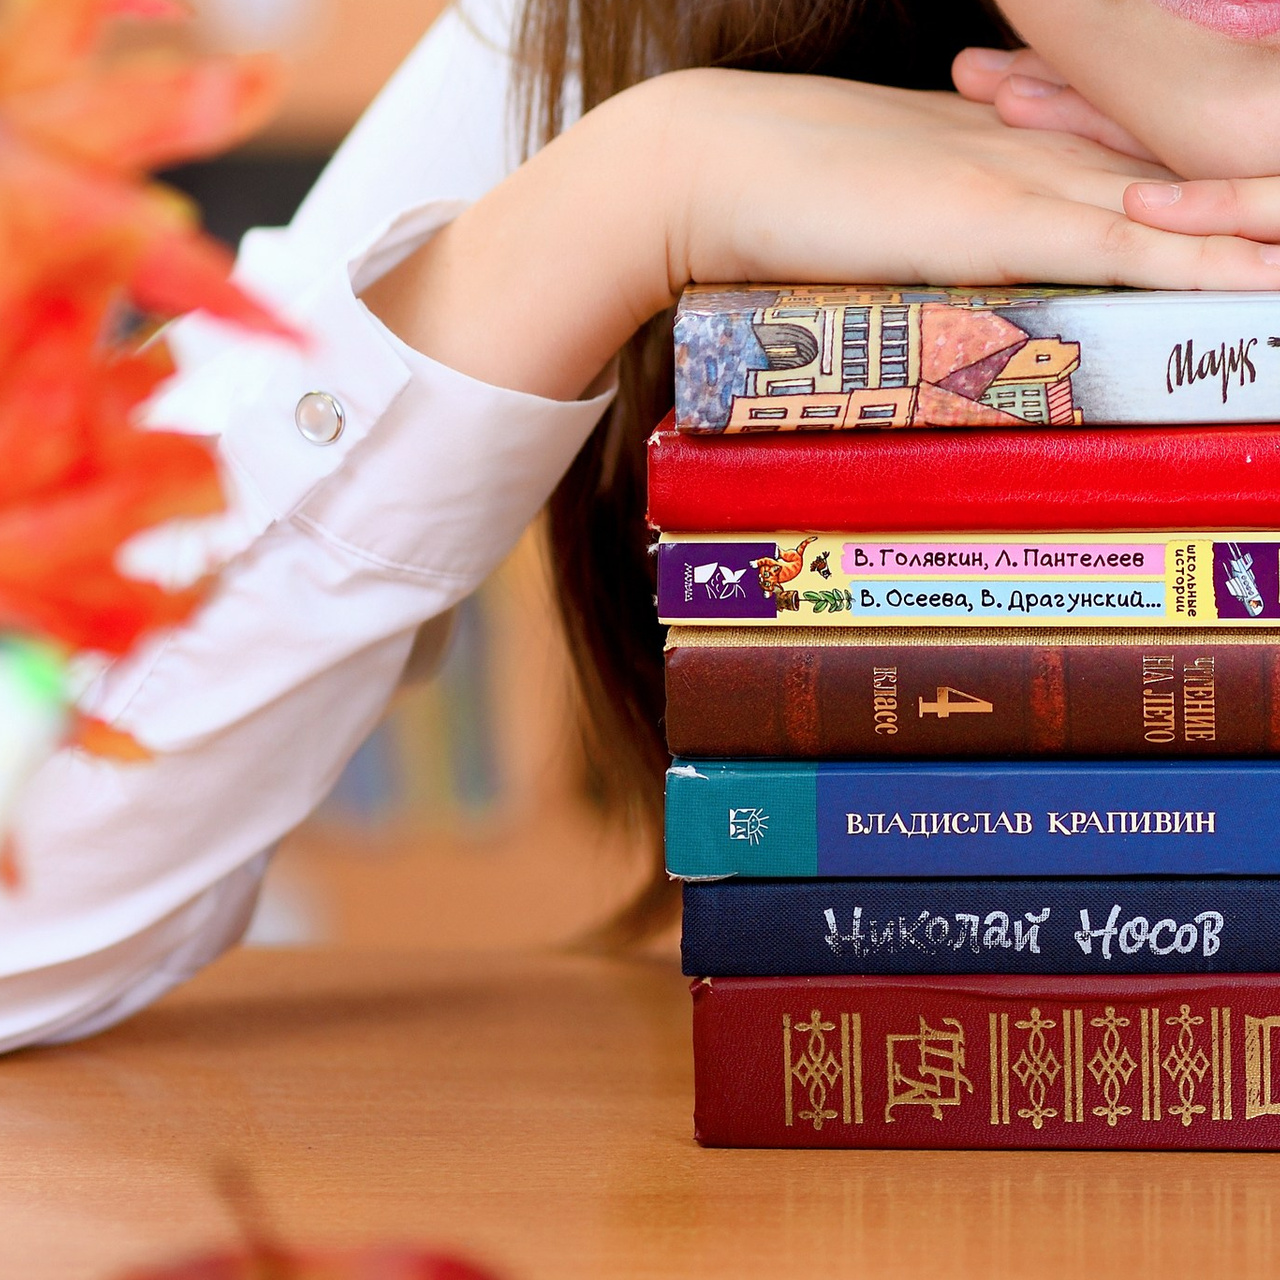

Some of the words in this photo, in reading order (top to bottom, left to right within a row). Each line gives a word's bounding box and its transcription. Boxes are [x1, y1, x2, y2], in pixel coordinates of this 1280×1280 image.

[853, 549, 876, 568] В.
[880, 549, 990, 572] Голявкин,
[995, 549, 1019, 568] Л.
[1024, 550, 1145, 569] Пантелеев
[1172, 548, 1186, 613] истории
[1186, 544, 1198, 618] школьные
[860, 589, 883, 609] В.
[887, 589, 973, 612] Осеева,
[981, 589, 1003, 609] В.
[1142, 654, 1175, 685] НА
[873, 666, 899, 735] класс
[918, 686, 994, 719] 4
[1142, 689, 1176, 743] ЛЕТО
[1183, 656, 1216, 741] ЧТЕНИЕ
[845, 812, 1032, 839] ВЛАДИСЛАВ
[1047, 812, 1216, 835] КРАПИВИН
[1074, 904, 1224, 960] Носов
